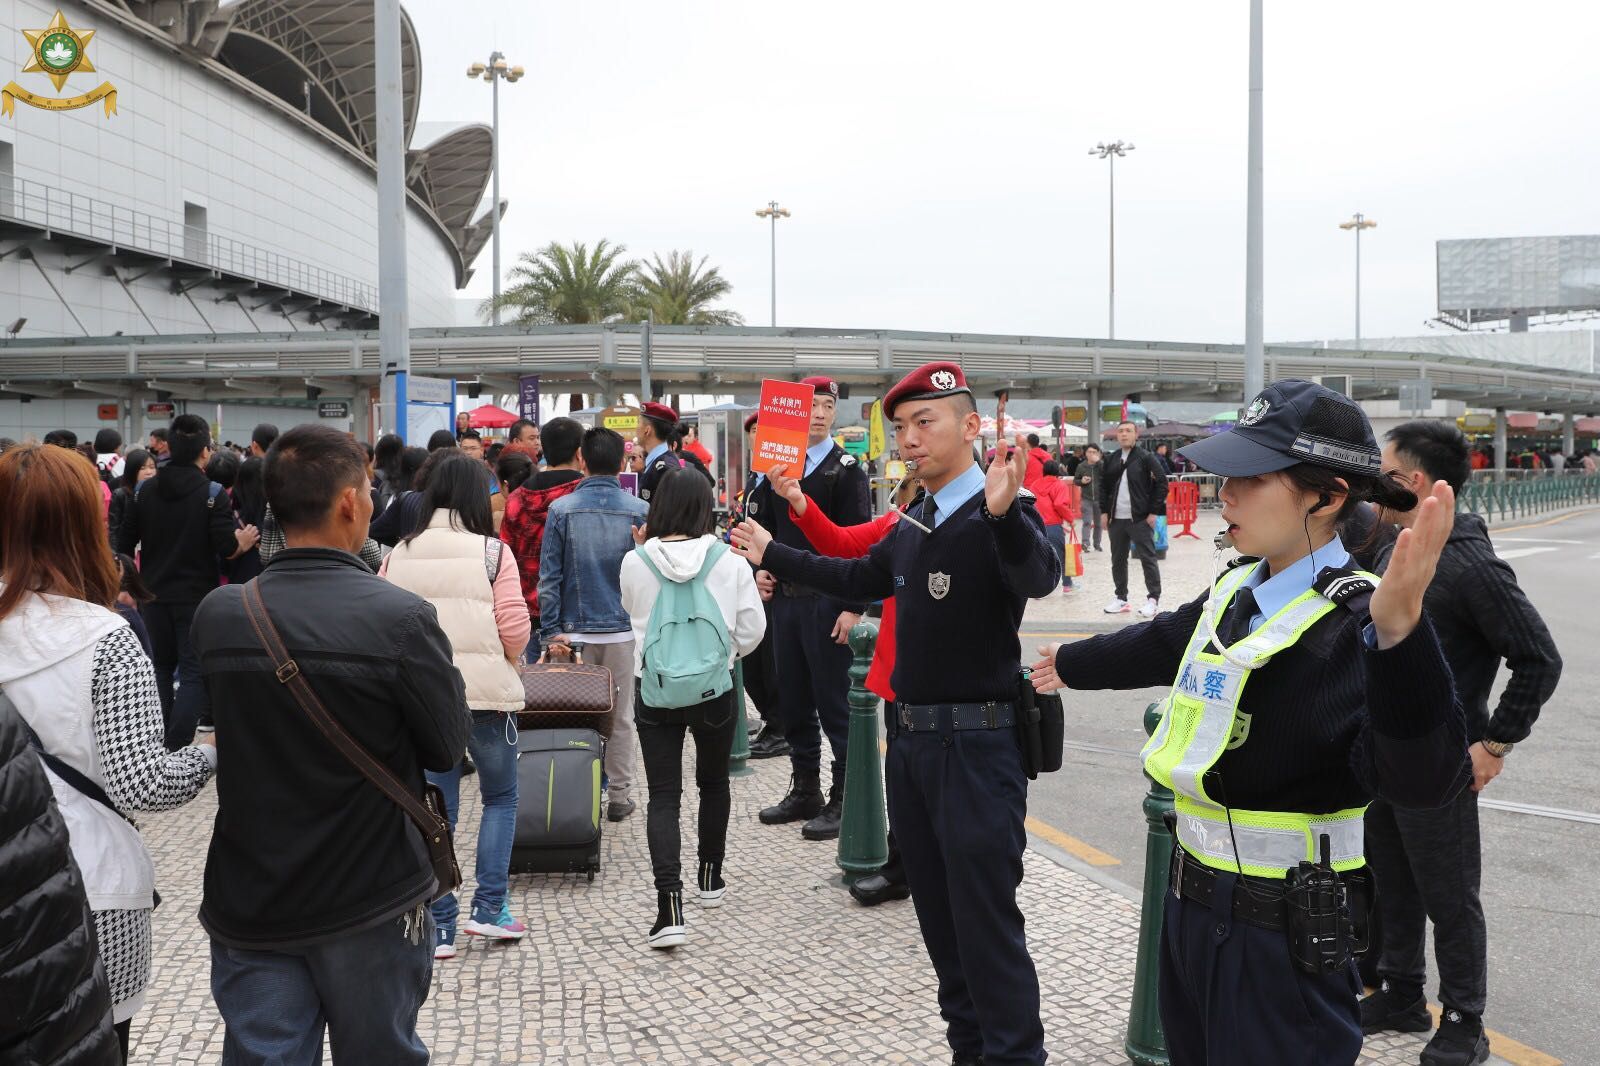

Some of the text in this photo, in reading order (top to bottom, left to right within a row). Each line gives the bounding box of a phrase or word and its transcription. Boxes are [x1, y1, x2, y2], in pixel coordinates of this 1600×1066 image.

[772, 396, 801, 409] 永利澳門
[763, 405, 807, 418] WYNN MACAU
[761, 441, 798, 456] 澳門美高梅
[760, 452, 798, 464] MGM MACAU
[1202, 670, 1227, 700] 察
